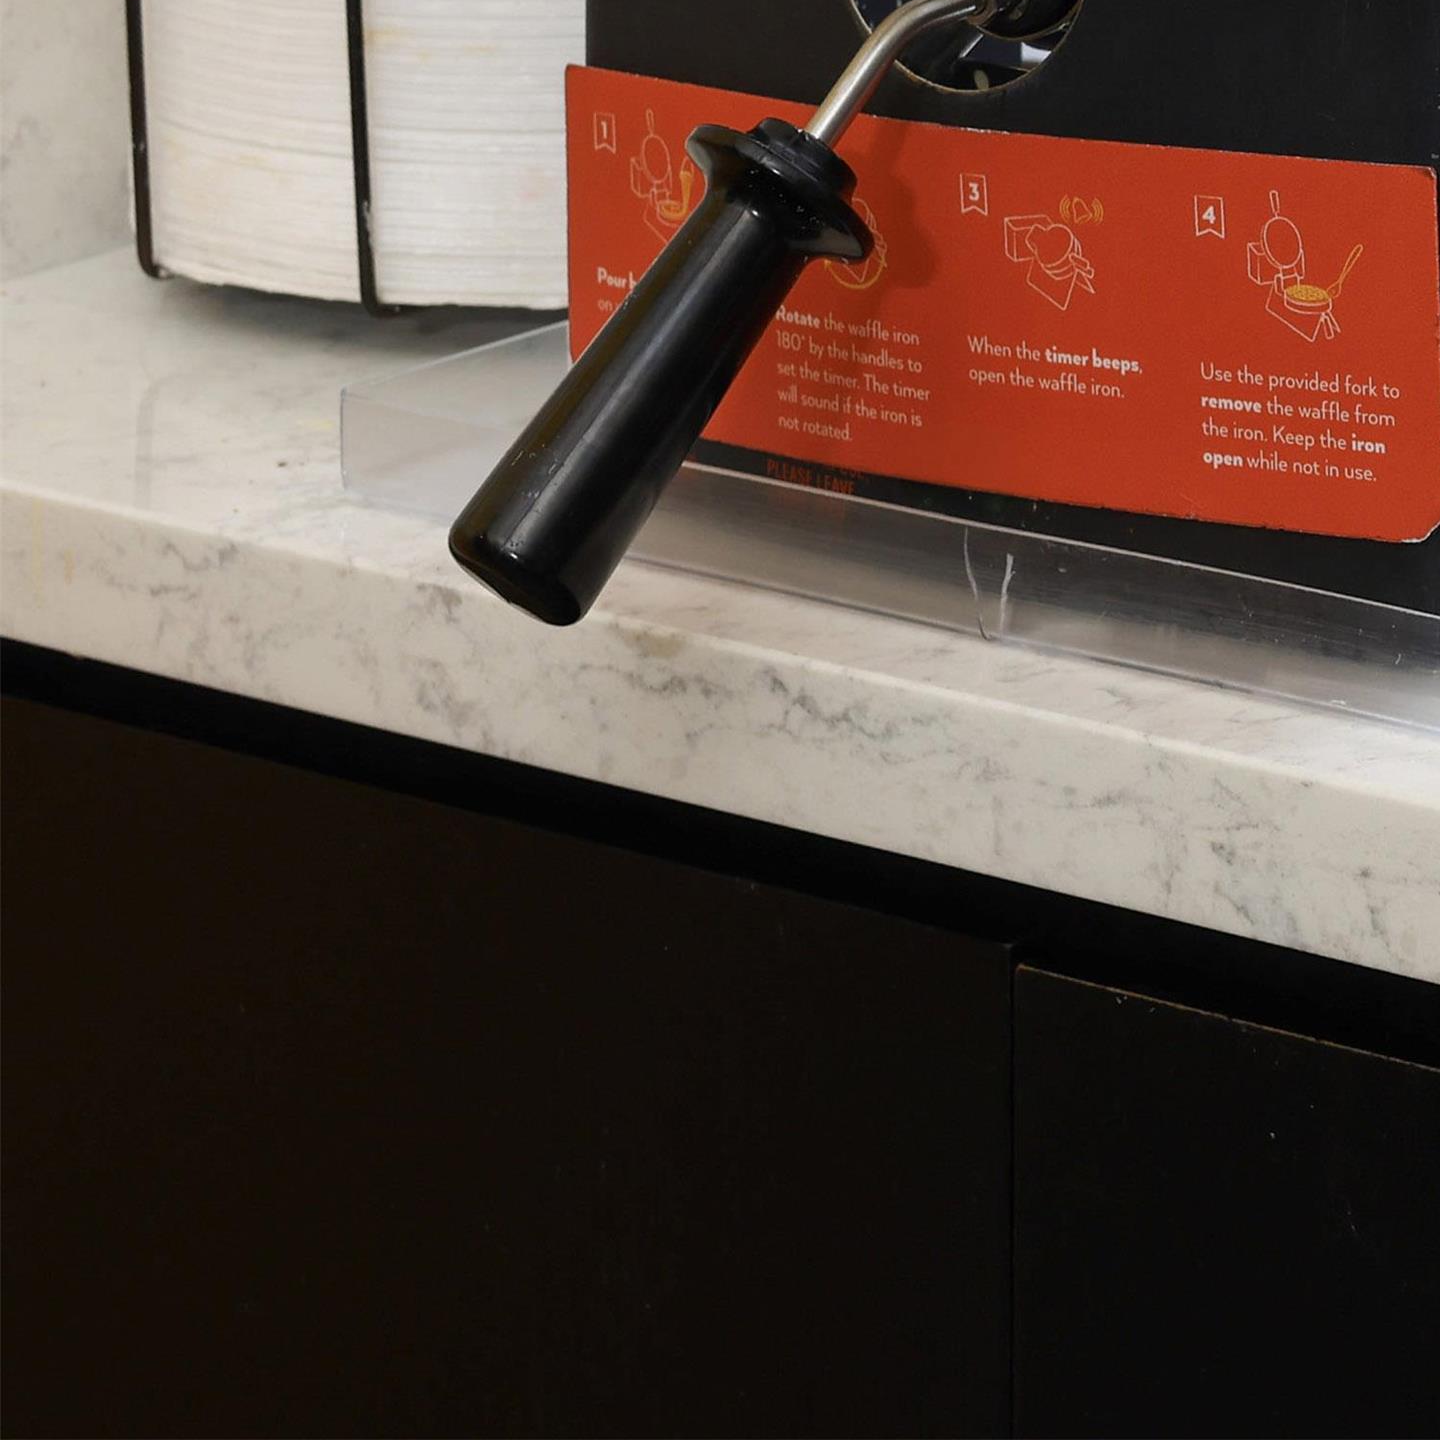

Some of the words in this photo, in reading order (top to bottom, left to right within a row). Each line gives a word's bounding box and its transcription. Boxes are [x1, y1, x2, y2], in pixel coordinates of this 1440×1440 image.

[1202, 205, 1216, 224] 4
[597, 267, 627, 289] Pour
[776, 305, 820, 329] Rotate
[824, 312, 845, 333] the
[848, 319, 890, 341] waffle
[893, 326, 920, 345] iron
[809, 339, 824, 359] by
[828, 341, 849, 358] the
[852, 345, 904, 370] handles
[907, 359, 923, 373] to
[967, 335, 1012, 357] When
[1016, 340, 1041, 361] the
[1045, 345, 1089, 366] timer
[1092, 348, 1143, 376] beeps,
[777, 362, 796, 377] set
[799, 362, 820, 381] the
[824, 368, 860, 390] timer.
[864, 373, 890, 395] The
[893, 381, 931, 401] timer
[969, 370, 1005, 385] open
[1010, 368, 1035, 388] the
[1039, 372, 1087, 394] waffle
[1091, 378, 1125, 398] iron.
[1200, 361, 1233, 382] Use
[1237, 364, 1264, 386] the
[1269, 371, 1340, 393] provided
[1344, 374, 1378, 397] fork
[1383, 384, 1400, 399] to
[777, 385, 798, 403] will
[801, 394, 839, 411] sound
[843, 397, 852, 414] if
[855, 399, 877, 419] the
[881, 407, 908, 424] iron
[911, 409, 923, 427] is
[1200, 396, 1263, 414] remove
[1267, 395, 1294, 417] the
[1298, 400, 1350, 423] waffle
[1354, 403, 1396, 427] from
[778, 415, 800, 431] not
[803, 421, 853, 441] rotated.
[1202, 416, 1229, 438] the
[1233, 421, 1268, 442] iron.
[1273, 425, 1315, 450] Keep
[1320, 429, 1347, 451] the
[1351, 433, 1386, 454] iron
[1203, 451, 1243, 470] open
[1247, 450, 1288, 472] while
[1293, 462, 1320, 476] not
[1325, 460, 1339, 478] in
[1344, 467, 1377, 482] use.
